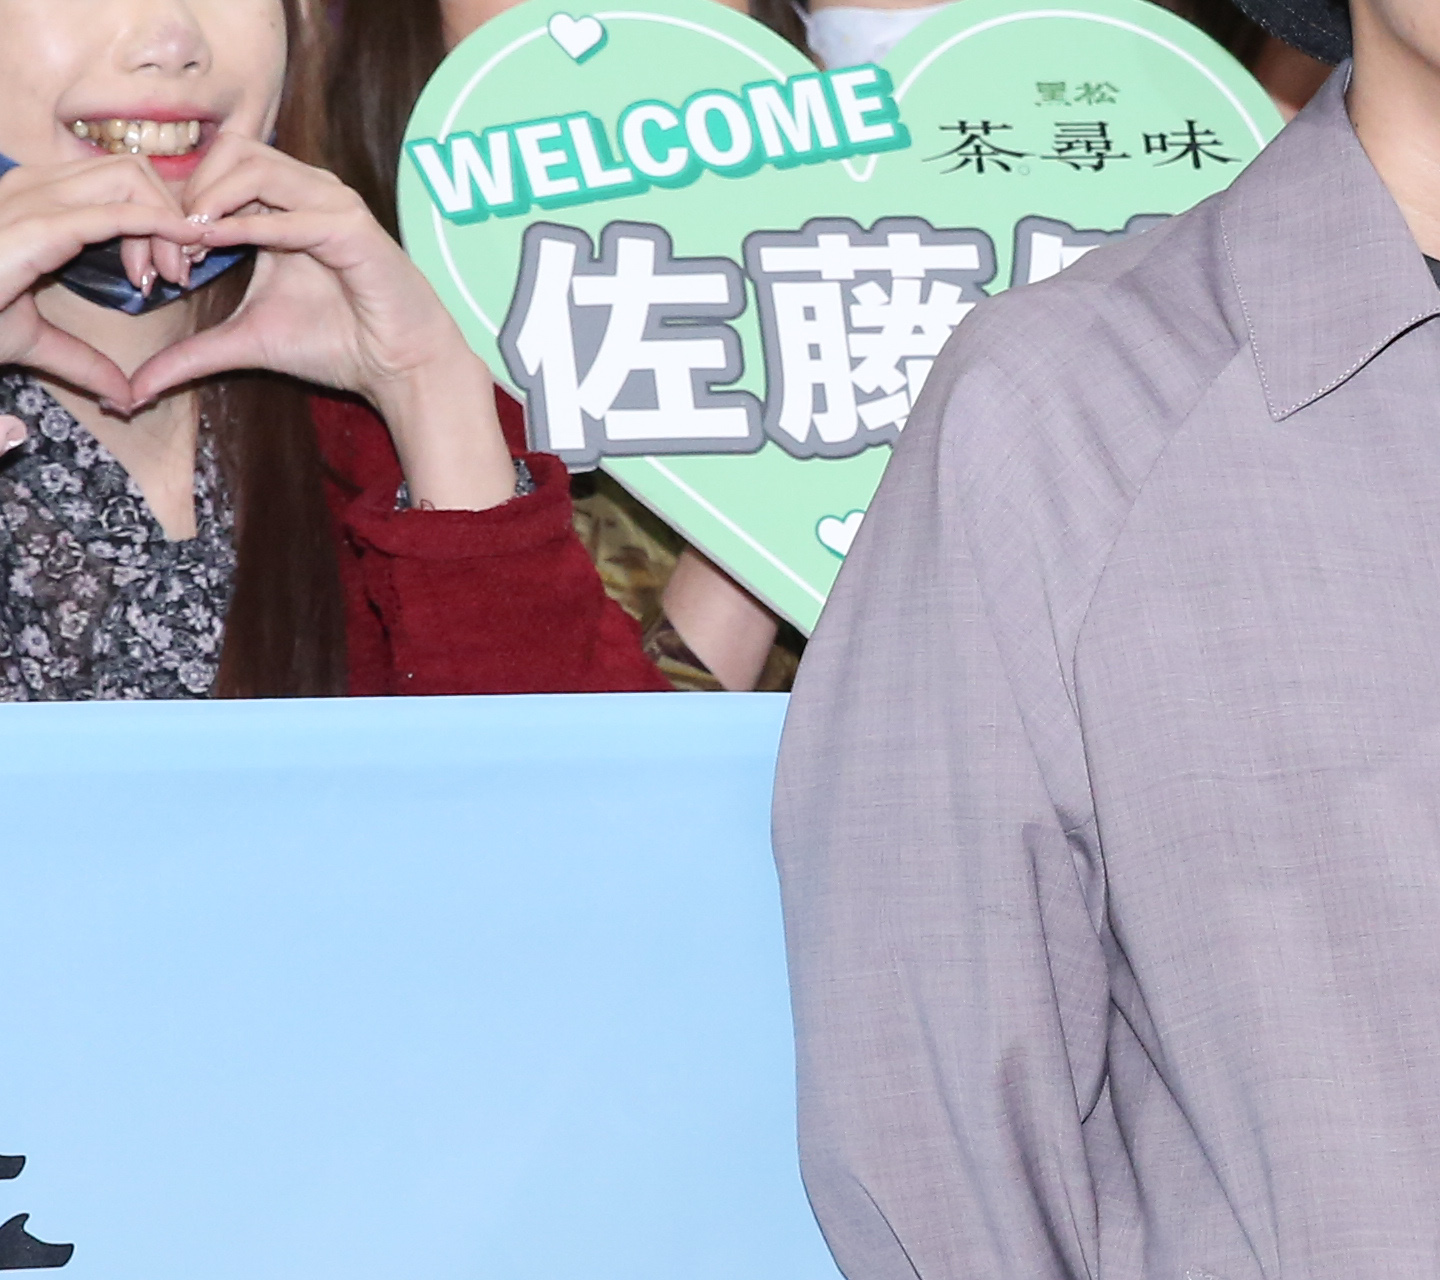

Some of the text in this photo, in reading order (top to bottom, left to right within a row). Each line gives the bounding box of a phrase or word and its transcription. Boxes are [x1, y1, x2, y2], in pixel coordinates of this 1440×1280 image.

[412, 65, 896, 215] WELCOME
[1033, 81, 1120, 107] 黑松
[921, 120, 1243, 175] 茶尋味
[515, 231, 1100, 451] 佐藤
